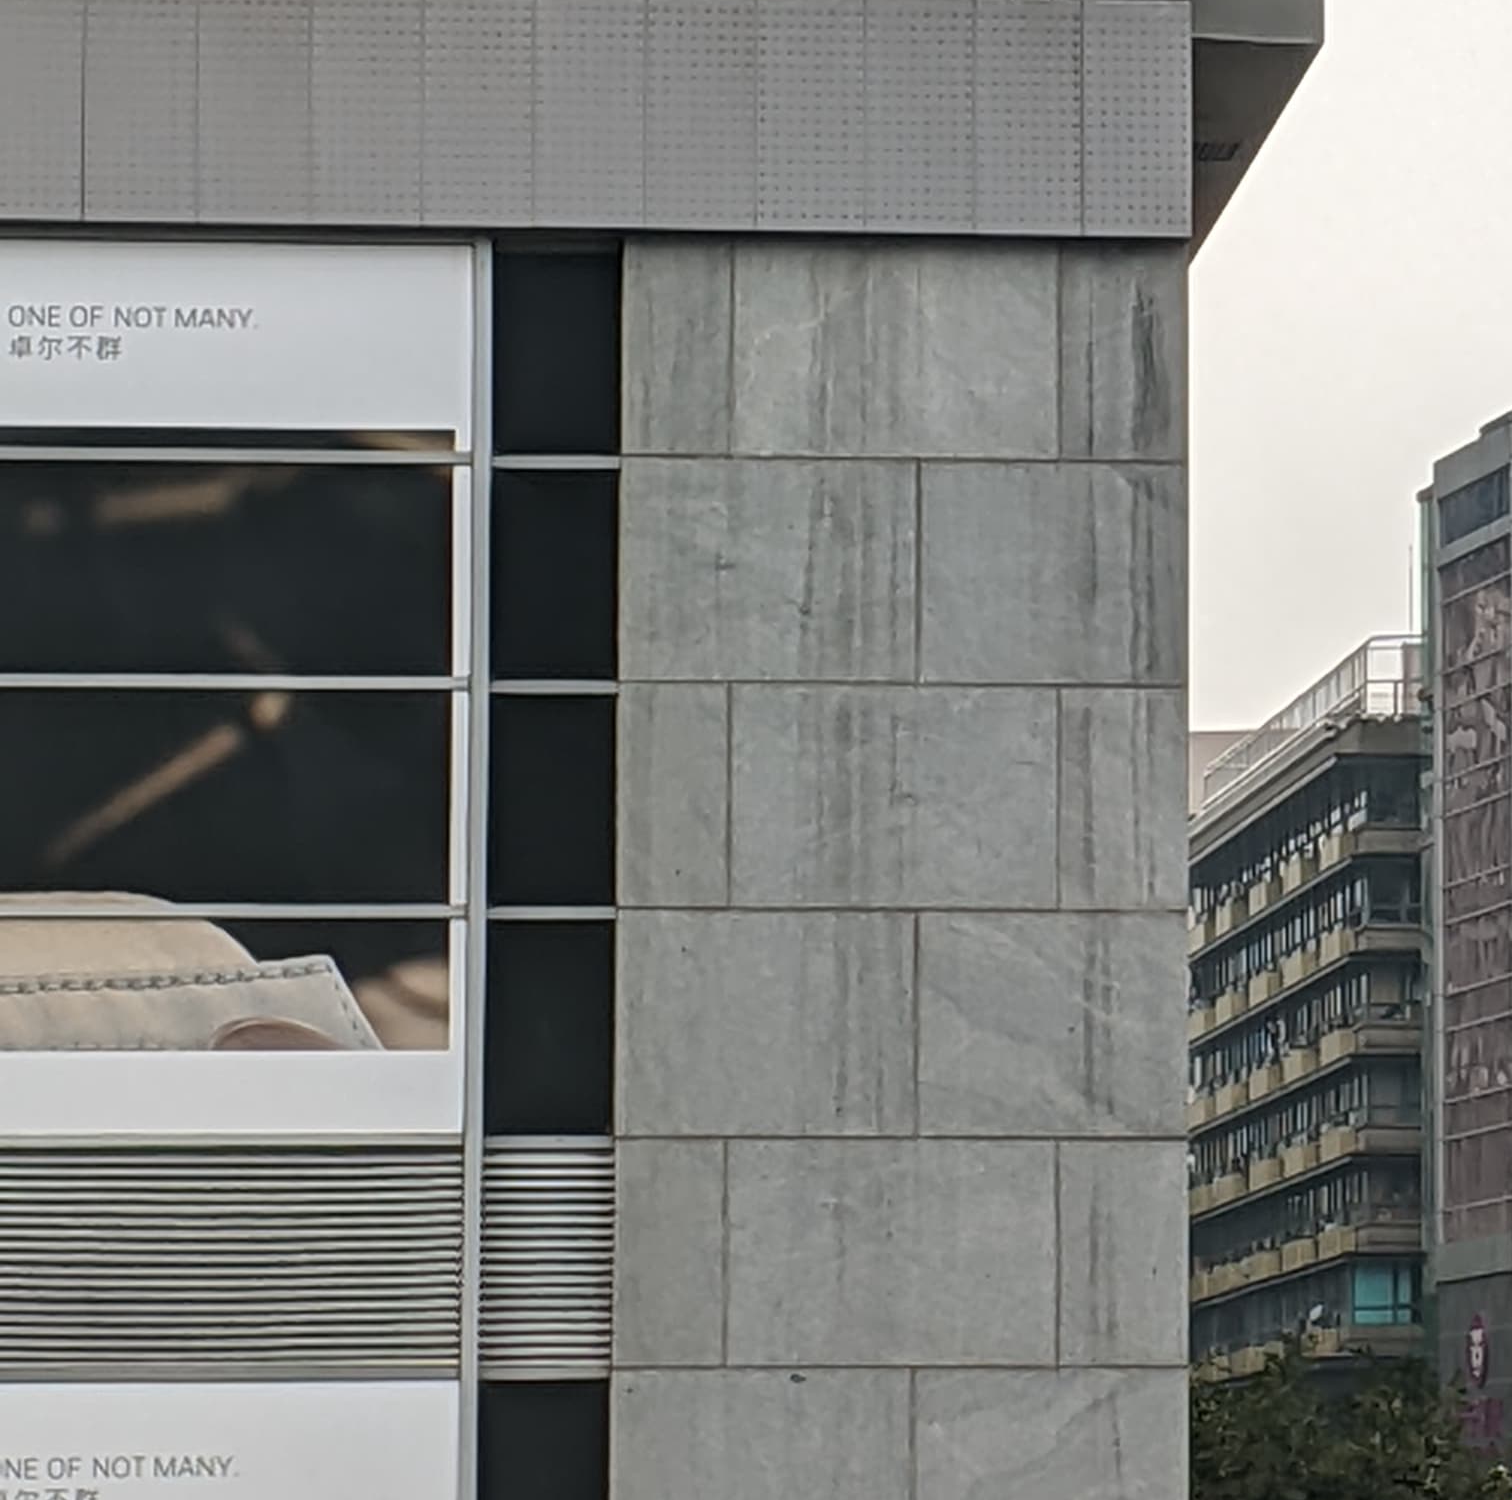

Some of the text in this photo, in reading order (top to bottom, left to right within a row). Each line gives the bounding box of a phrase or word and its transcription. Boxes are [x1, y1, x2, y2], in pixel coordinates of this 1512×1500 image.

[8, 305, 259, 329] ONE OF NOT MANY.
[9, 335, 122, 361] 卓尔不群
[0, 1455, 239, 1480] NE OF NOT MANY.
